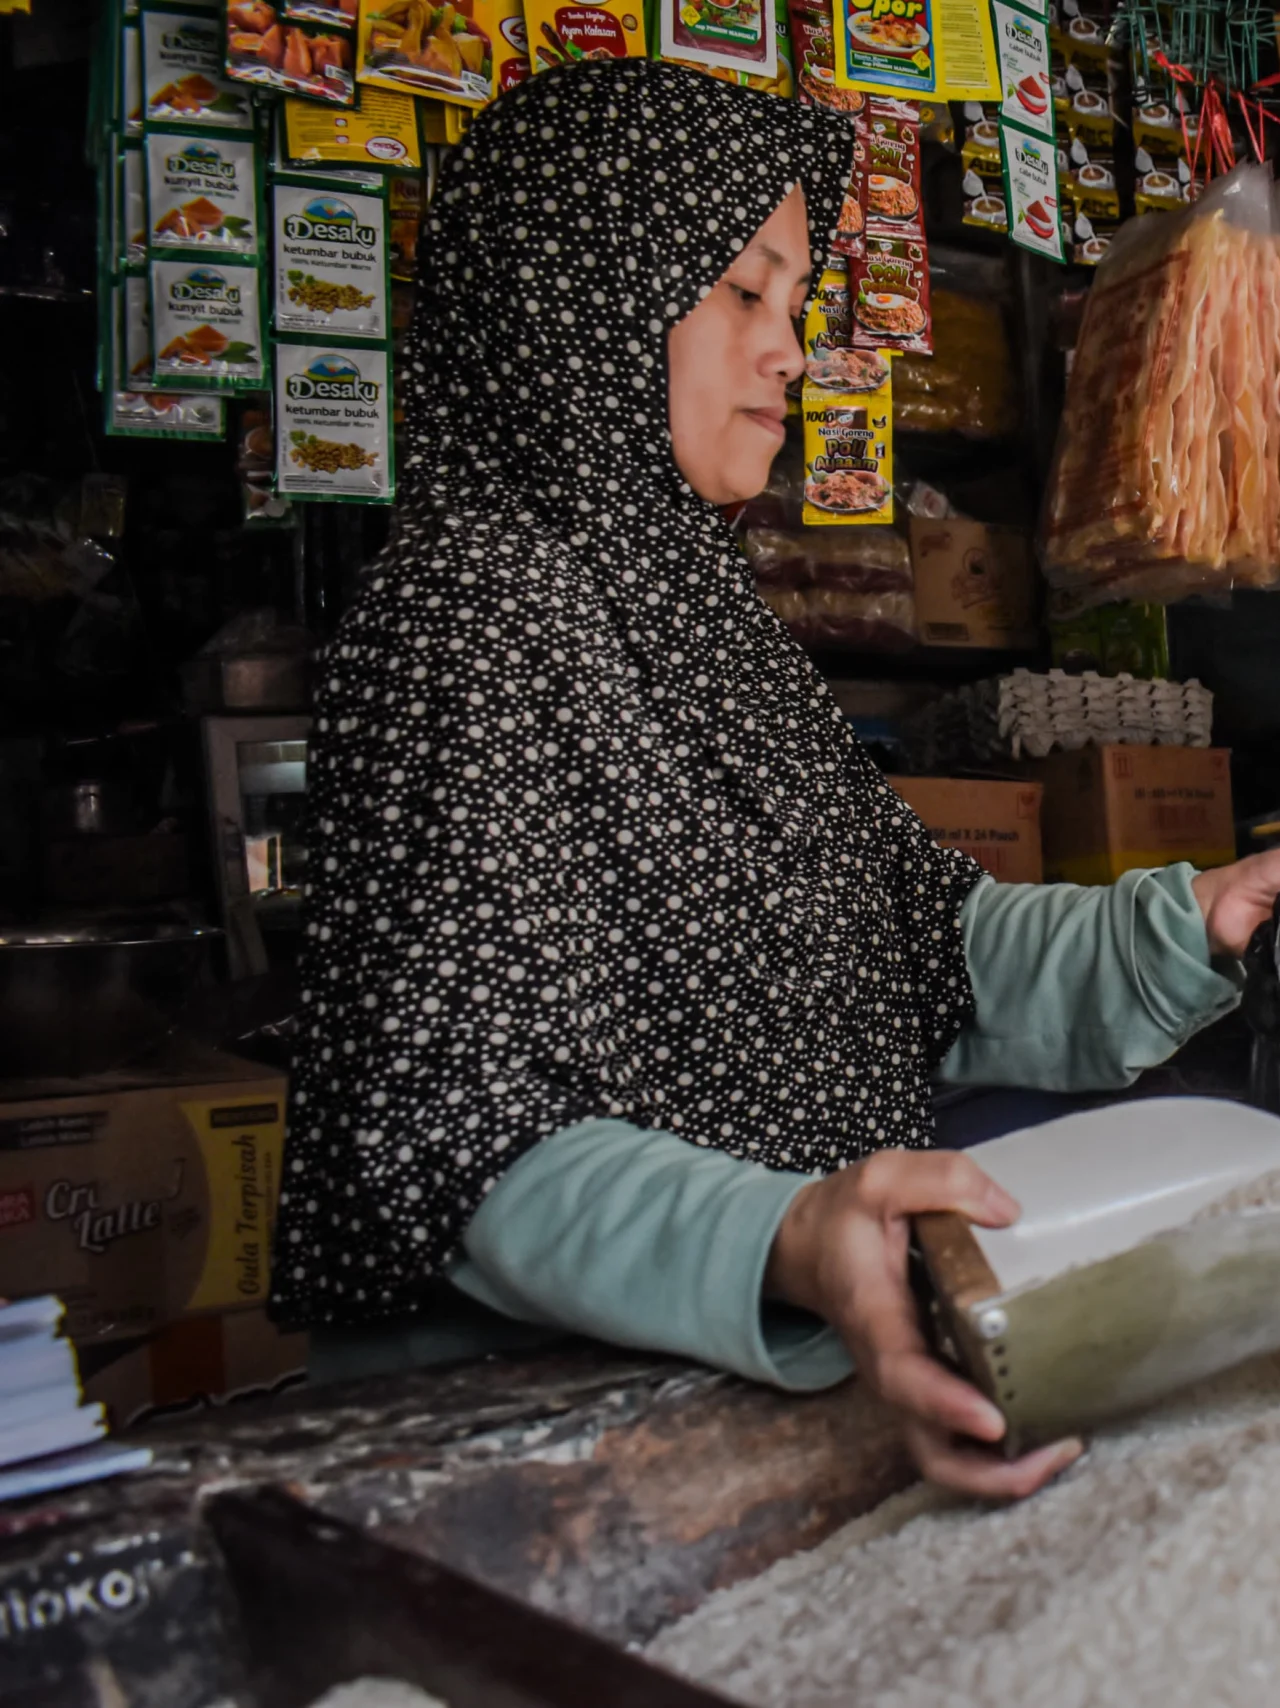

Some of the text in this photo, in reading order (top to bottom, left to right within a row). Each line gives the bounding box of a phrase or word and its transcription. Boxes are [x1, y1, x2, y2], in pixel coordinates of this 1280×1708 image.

[167, 156, 235, 180] Desaku
[205, 179, 240, 192] bubuk
[285, 213, 378, 250] Desaku
[283, 243, 377, 263] ketumbar bubuk
[172, 280, 241, 304] Desaku
[168, 302, 244, 318] kunyit bubuk
[818, 305, 840, 314] Nasi
[288, 375, 378, 406] Desaku
[285, 404, 380, 420] ketumbar bubuk
[805, 410, 834, 422] 1000
[818, 427, 875, 439] Nasi Goreng
